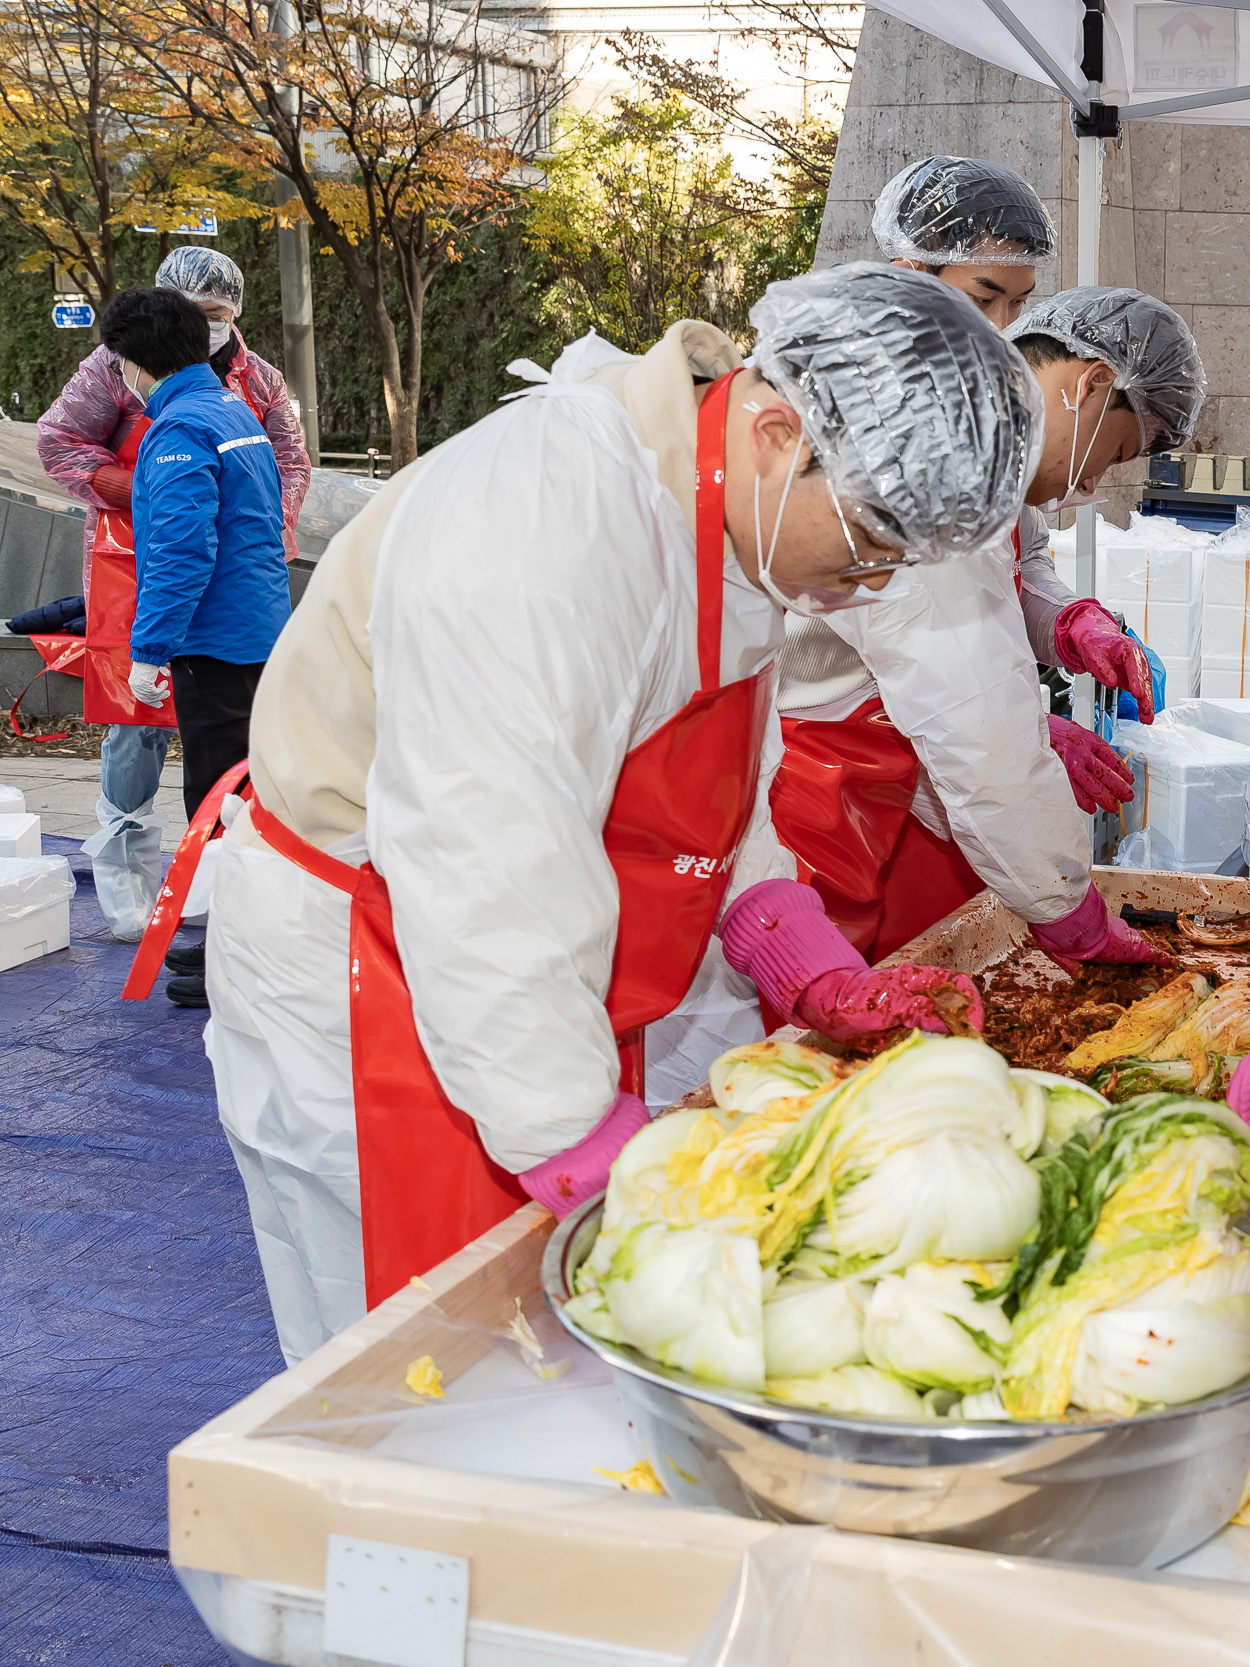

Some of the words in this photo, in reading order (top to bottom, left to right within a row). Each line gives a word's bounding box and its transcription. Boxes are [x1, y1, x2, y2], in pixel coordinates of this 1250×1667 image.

[155, 454, 175, 464] TEAM
[176, 453, 192, 462] 629
[672, 854, 718, 879] 광진
